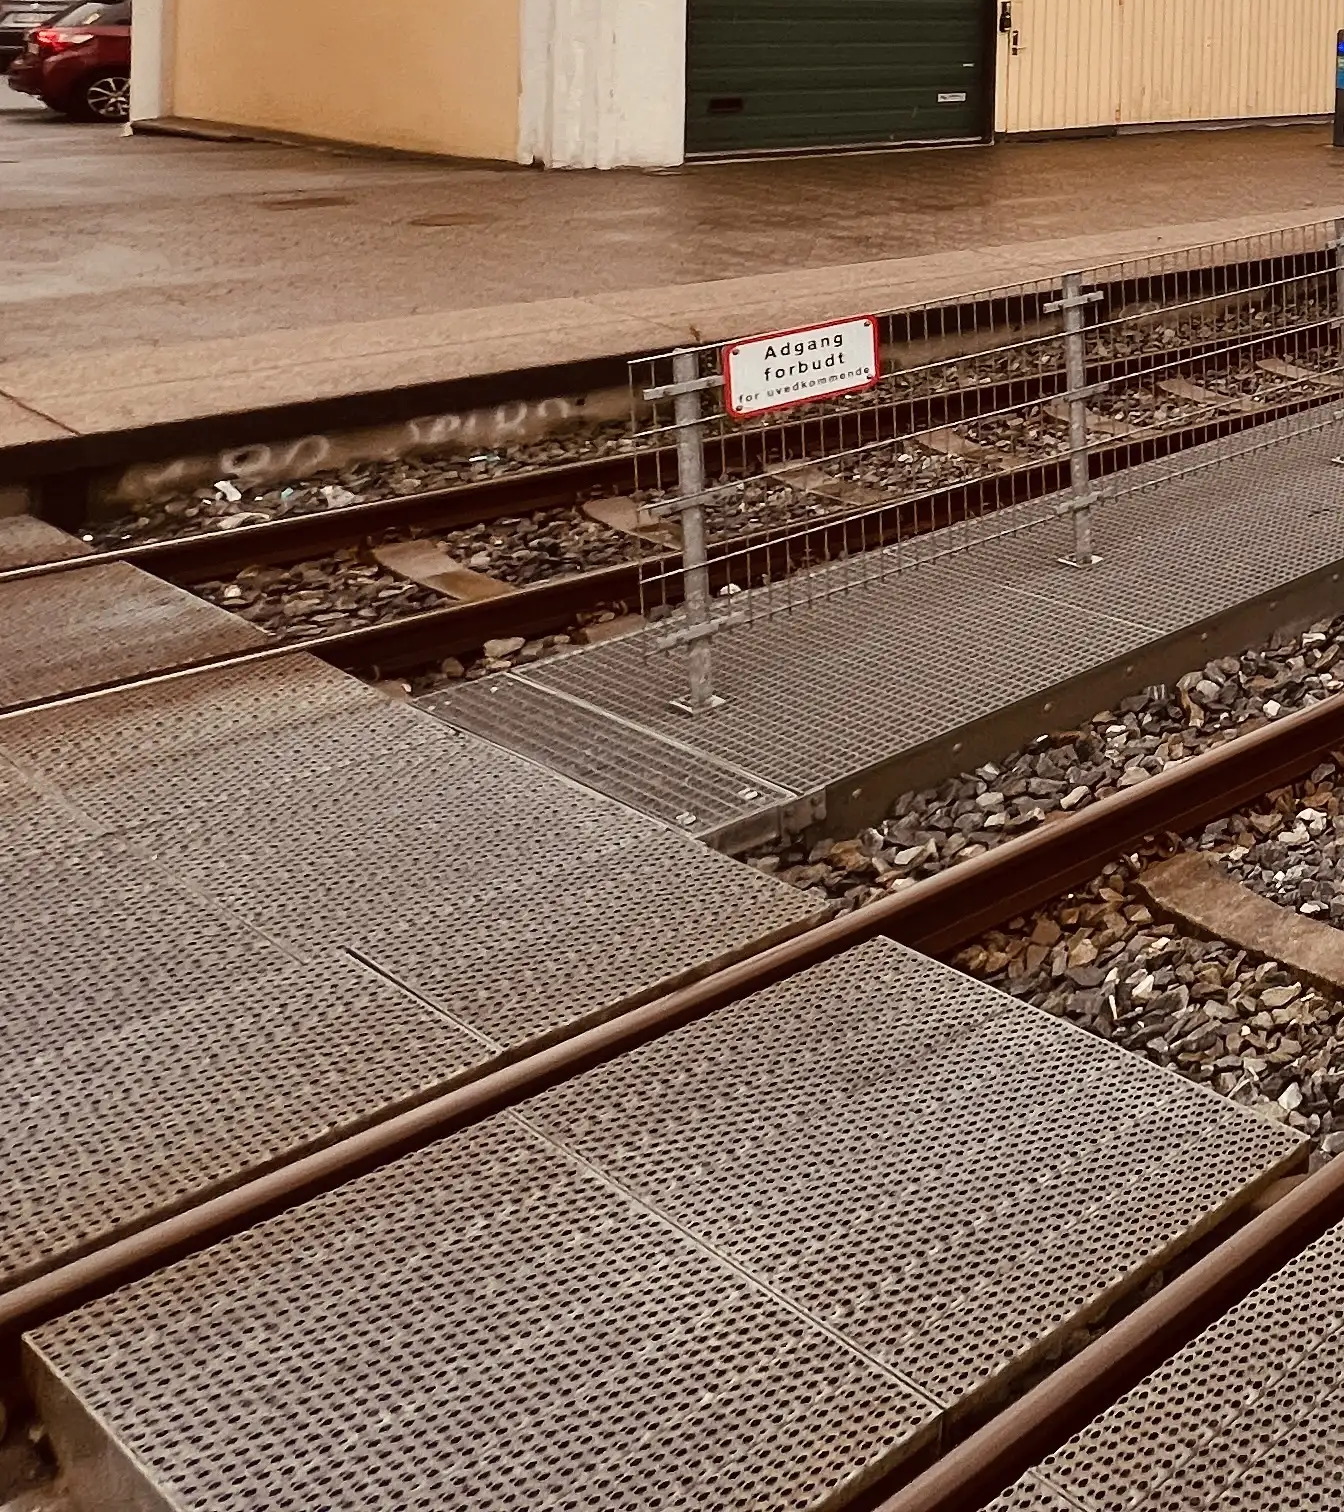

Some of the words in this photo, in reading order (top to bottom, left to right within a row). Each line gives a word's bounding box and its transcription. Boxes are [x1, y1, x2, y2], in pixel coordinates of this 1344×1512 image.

[764, 334, 843, 360] Adgang
[764, 352, 845, 381] forbudt
[738, 392, 760, 403] for
[767, 367, 870, 397] uvedkommende
